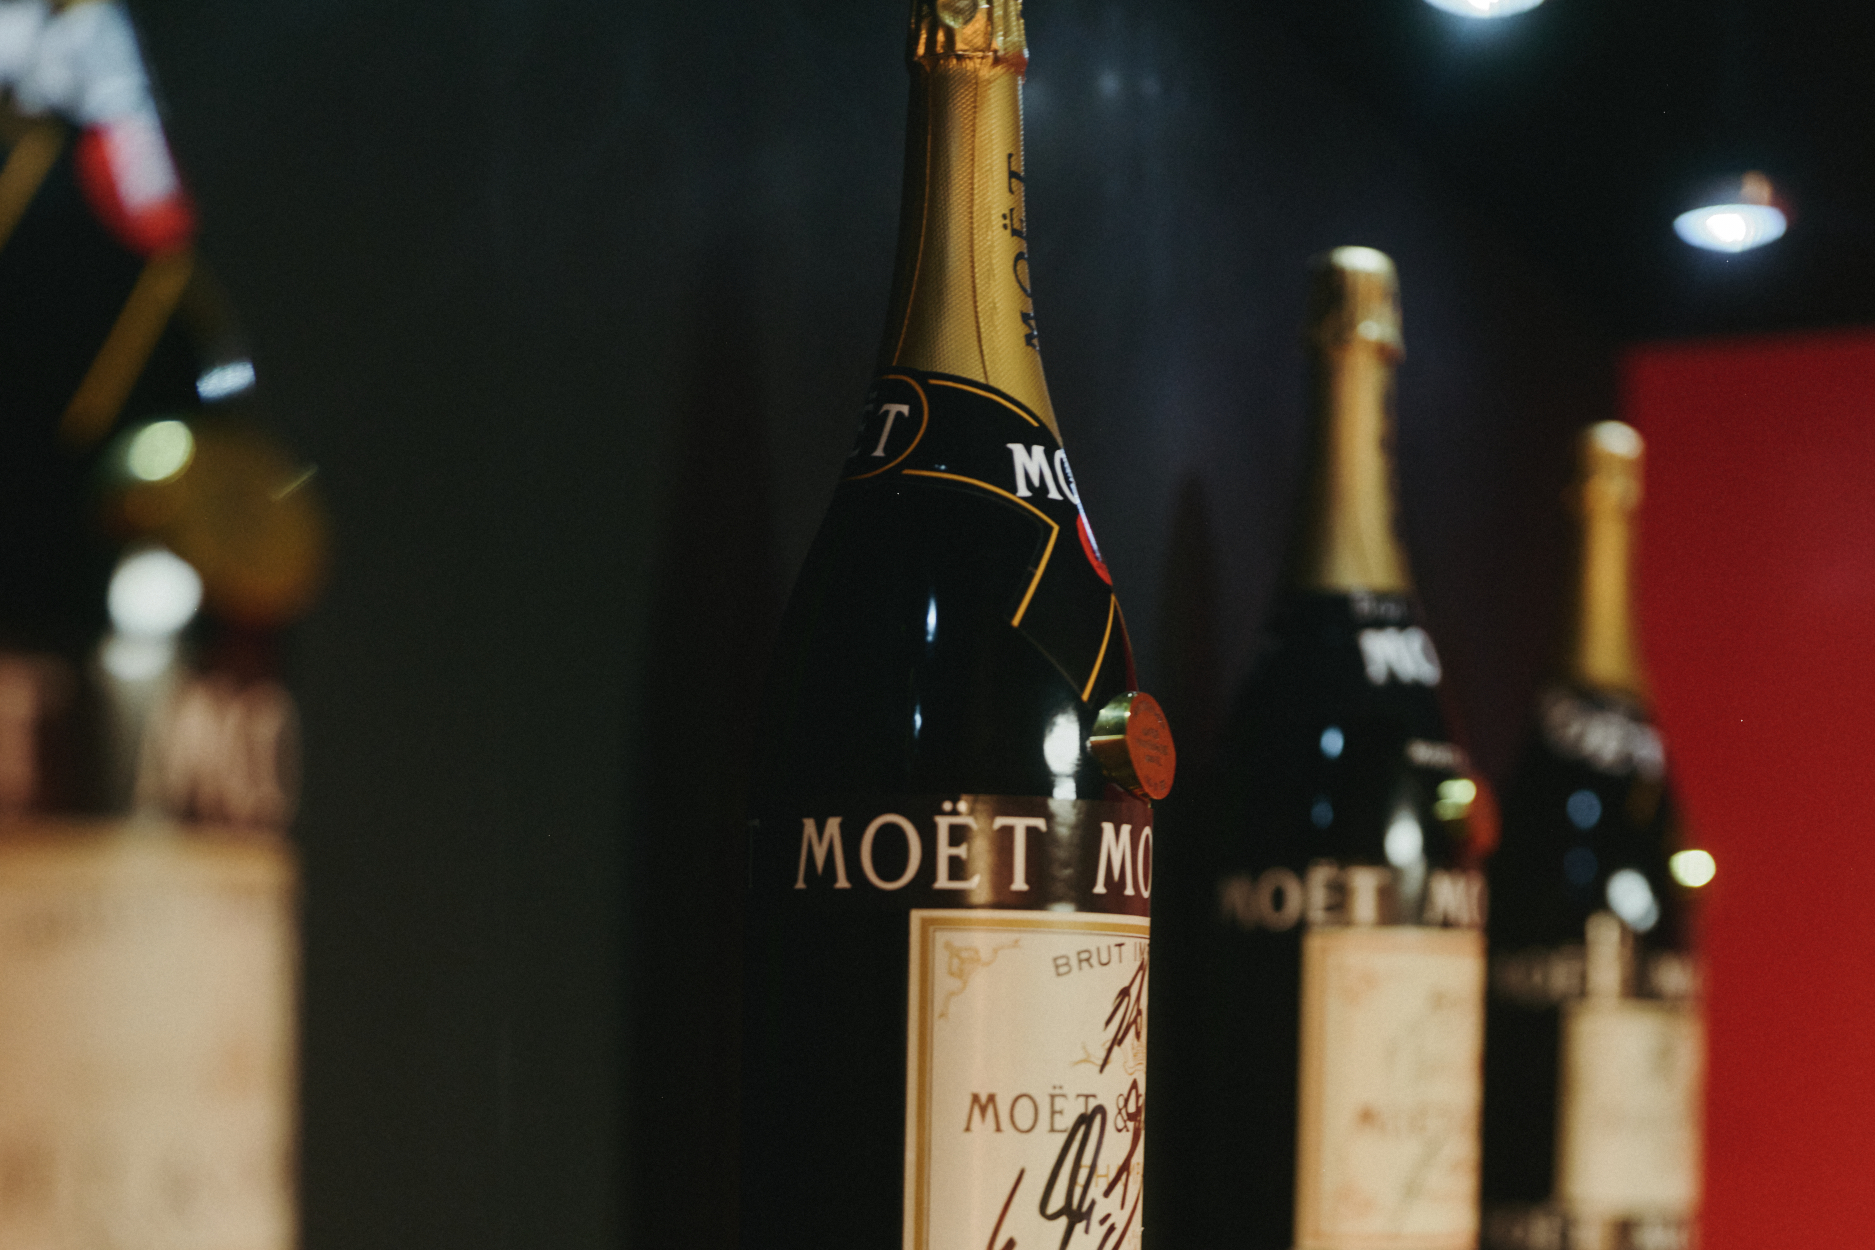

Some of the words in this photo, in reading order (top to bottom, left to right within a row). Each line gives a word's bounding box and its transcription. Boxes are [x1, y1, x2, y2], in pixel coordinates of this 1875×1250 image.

[794, 800, 1050, 891] MOËT
[1053, 942, 1126, 977] BRUT
[964, 1085, 1097, 1134] MOËT
